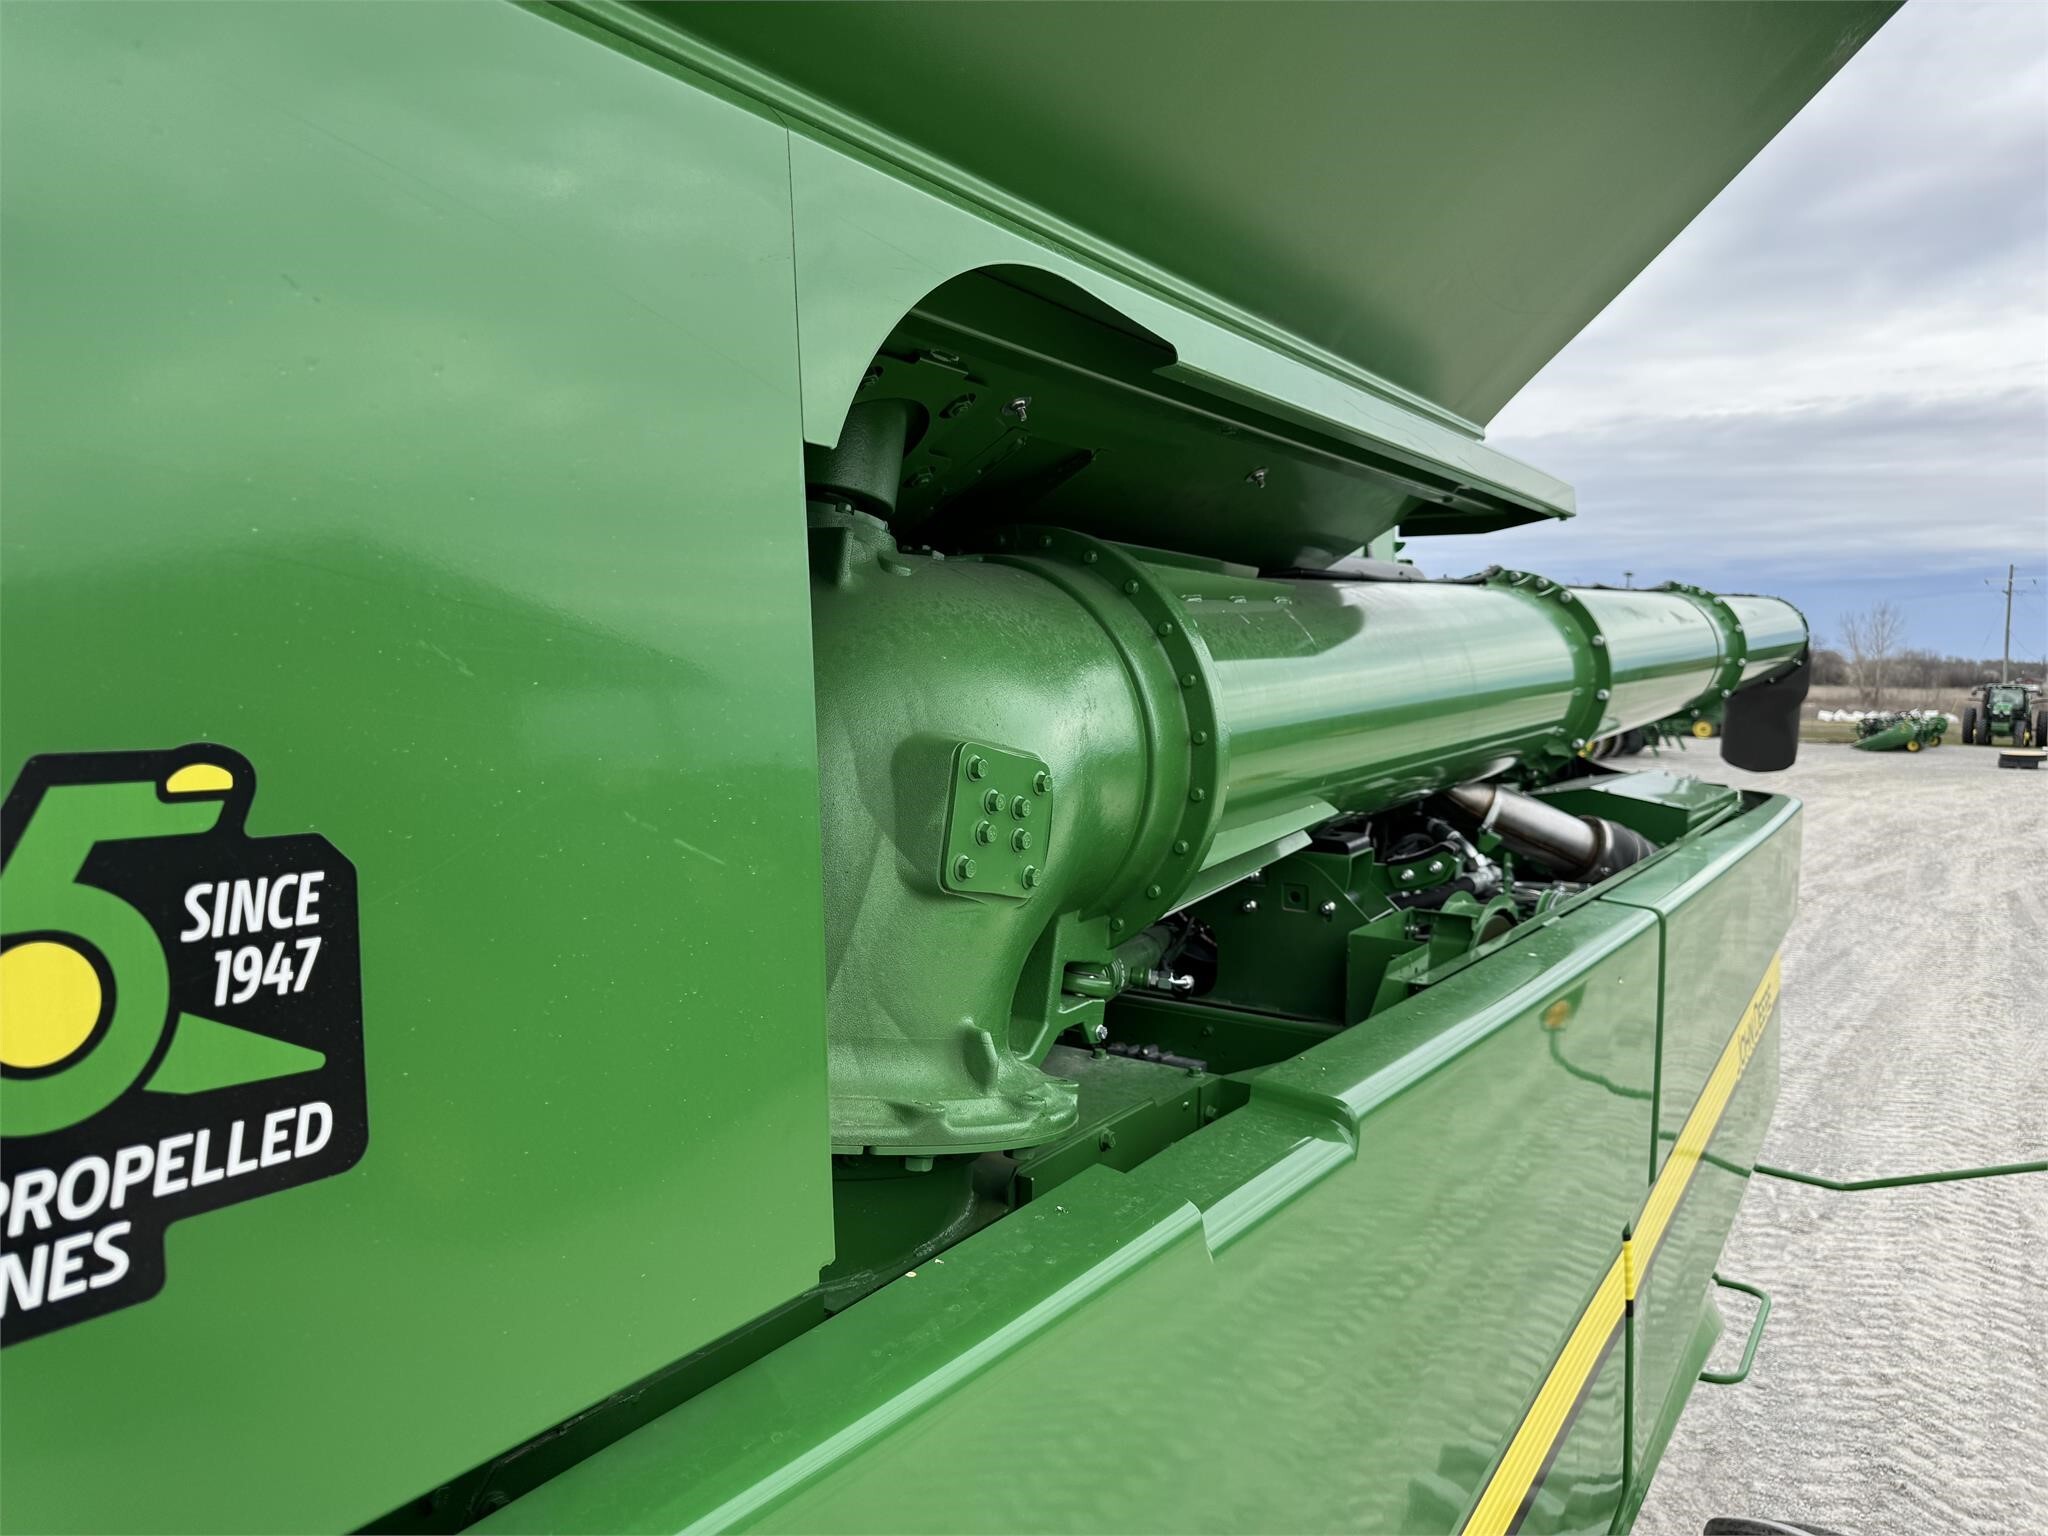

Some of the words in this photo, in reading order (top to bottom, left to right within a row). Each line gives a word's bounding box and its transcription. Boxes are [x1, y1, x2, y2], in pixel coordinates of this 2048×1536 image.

[180, 870, 325, 943] SINCE
[214, 936, 322, 1007] 1947
[0, 1102, 333, 1239] ROPELLED
